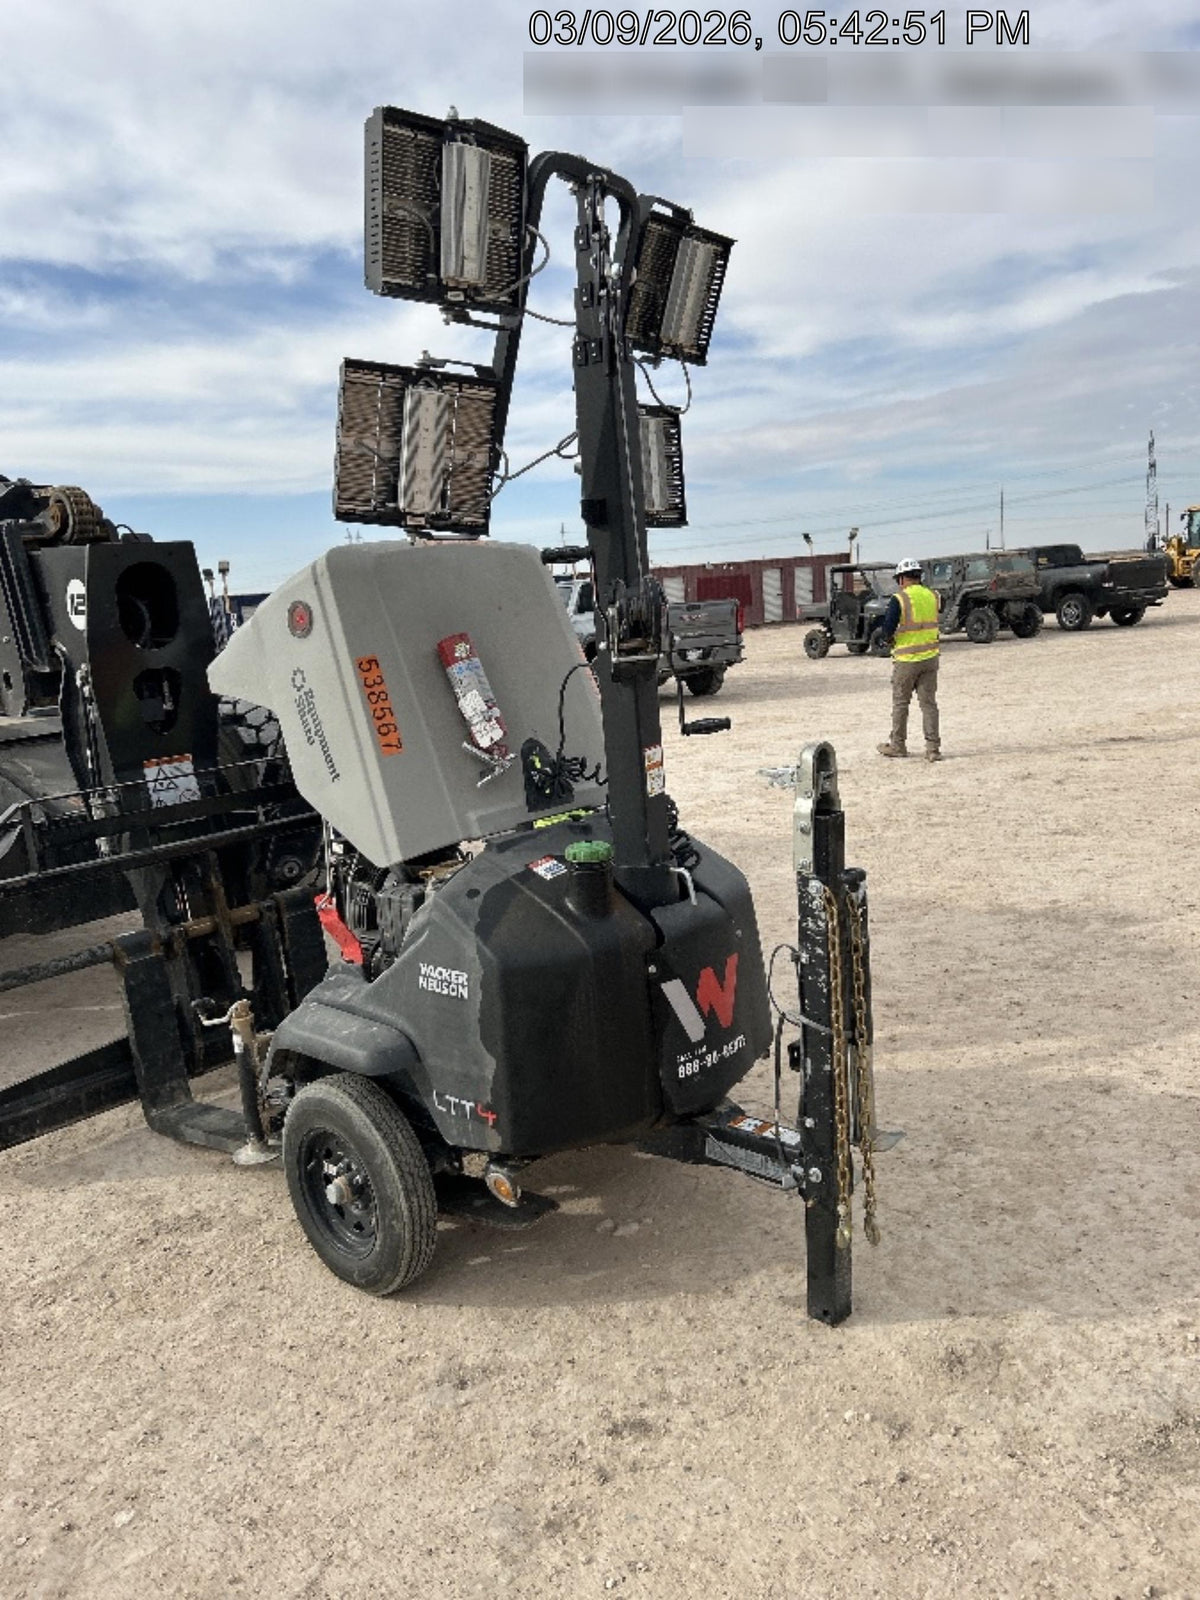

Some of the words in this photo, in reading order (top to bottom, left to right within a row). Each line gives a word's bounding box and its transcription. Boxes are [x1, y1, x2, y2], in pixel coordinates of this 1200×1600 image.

[358, 658, 403, 750] 538567
[418, 962, 469, 986] WACKER
[418, 975, 469, 1000] NEUSON
